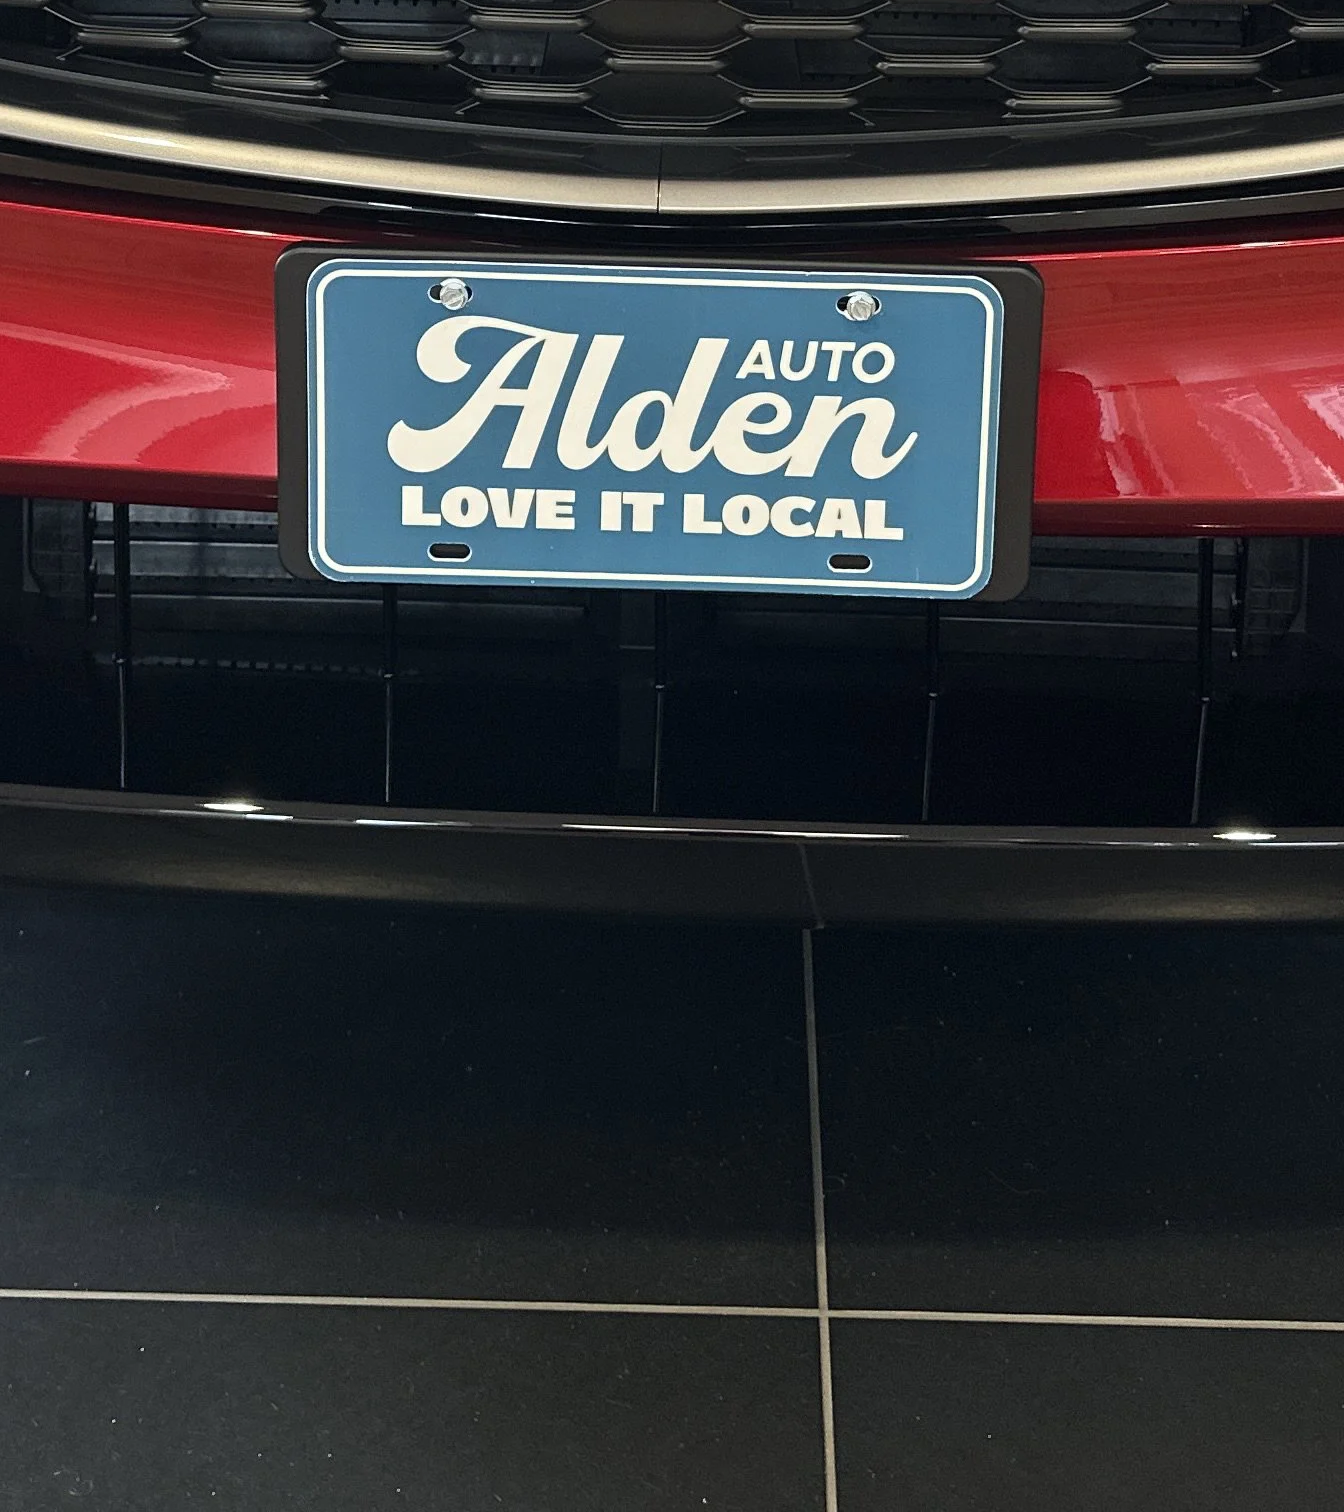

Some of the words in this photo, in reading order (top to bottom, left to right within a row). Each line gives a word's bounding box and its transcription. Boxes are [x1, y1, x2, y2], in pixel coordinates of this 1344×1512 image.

[735, 339, 896, 384] AUTO
[387, 315, 919, 480] Alden
[401, 485, 576, 530] LOVE
[600, 490, 665, 532] IT
[682, 493, 904, 541] LOCAL
